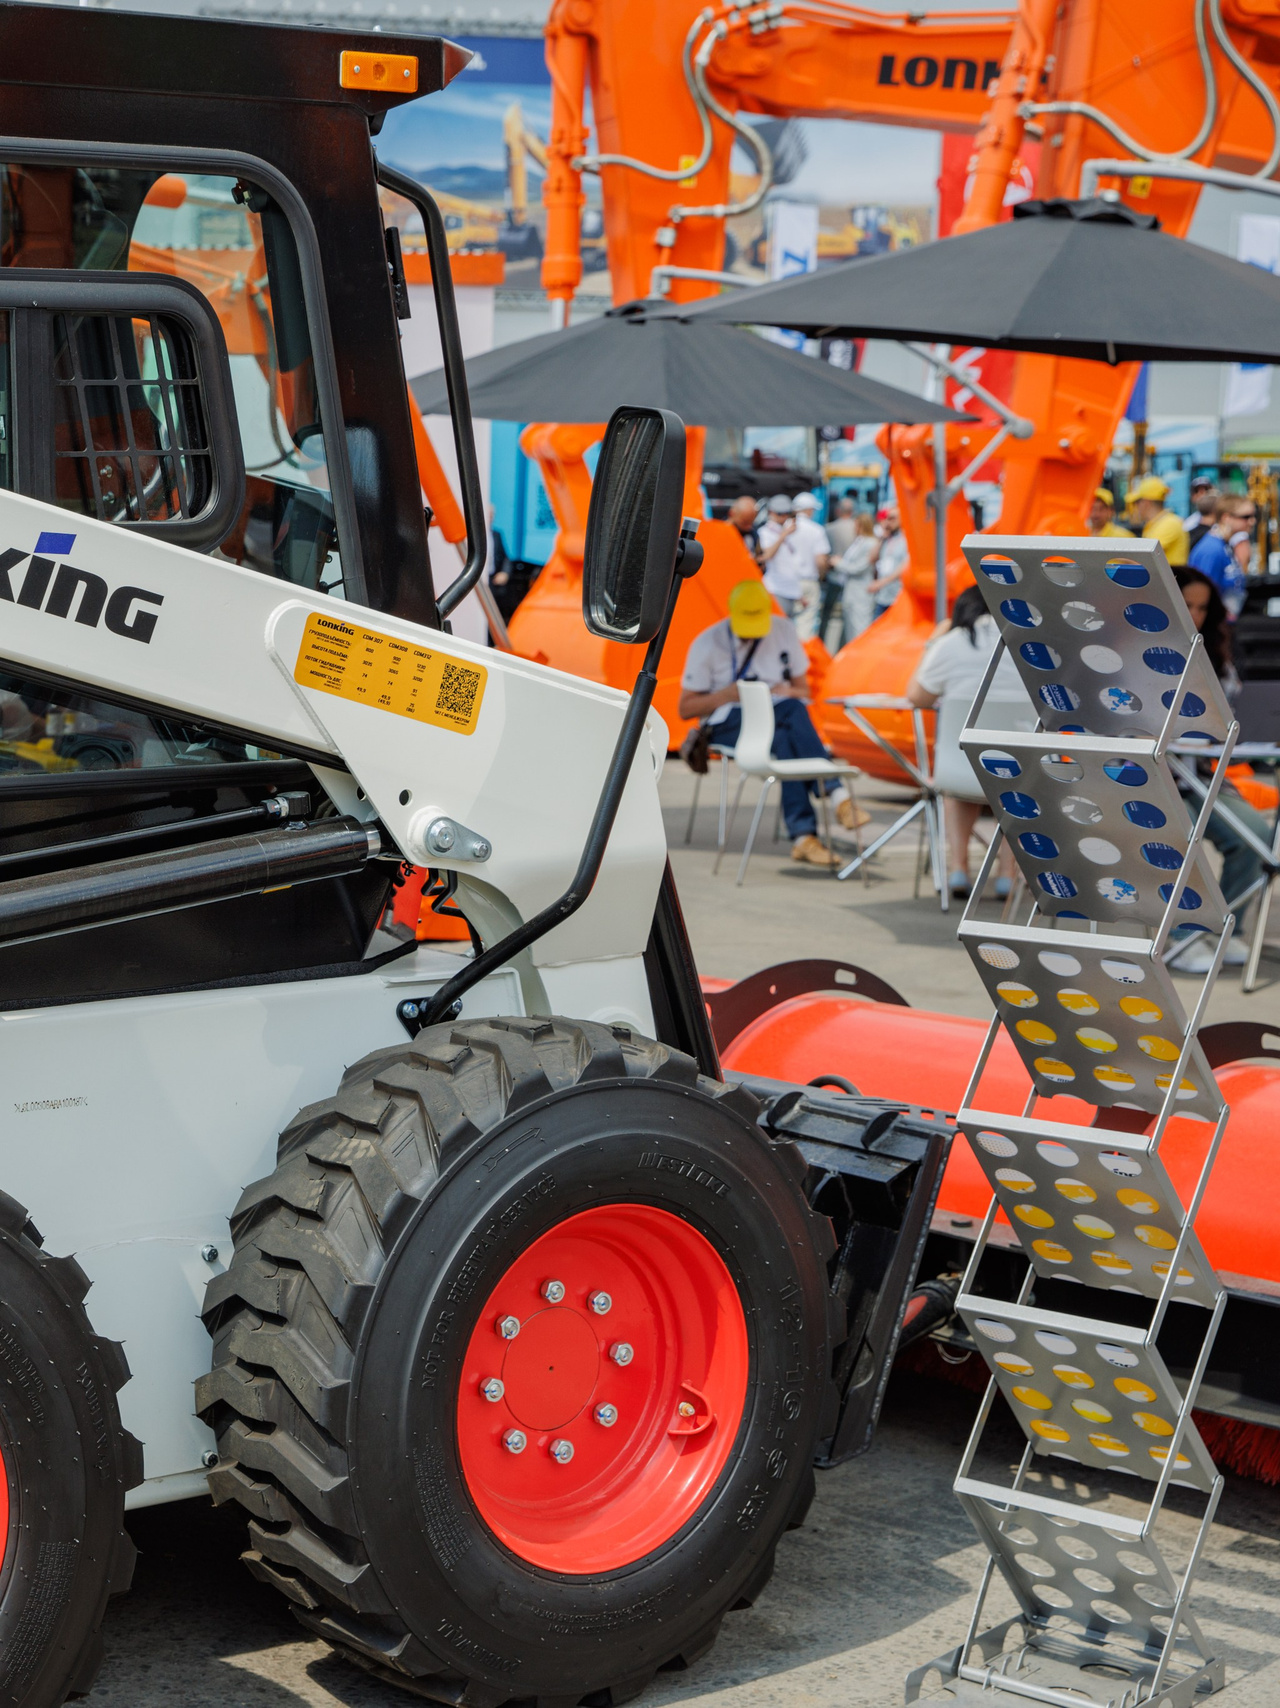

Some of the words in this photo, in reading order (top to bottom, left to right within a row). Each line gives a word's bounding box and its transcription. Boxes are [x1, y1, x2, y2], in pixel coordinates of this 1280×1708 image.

[317, 619, 355, 636] LONKING
[422, 1351, 441, 1388] NOT
[432, 1310, 455, 1343] FOR
[447, 1224, 500, 1304] HIGHWAY
[501, 1174, 557, 1229] SERVICE
